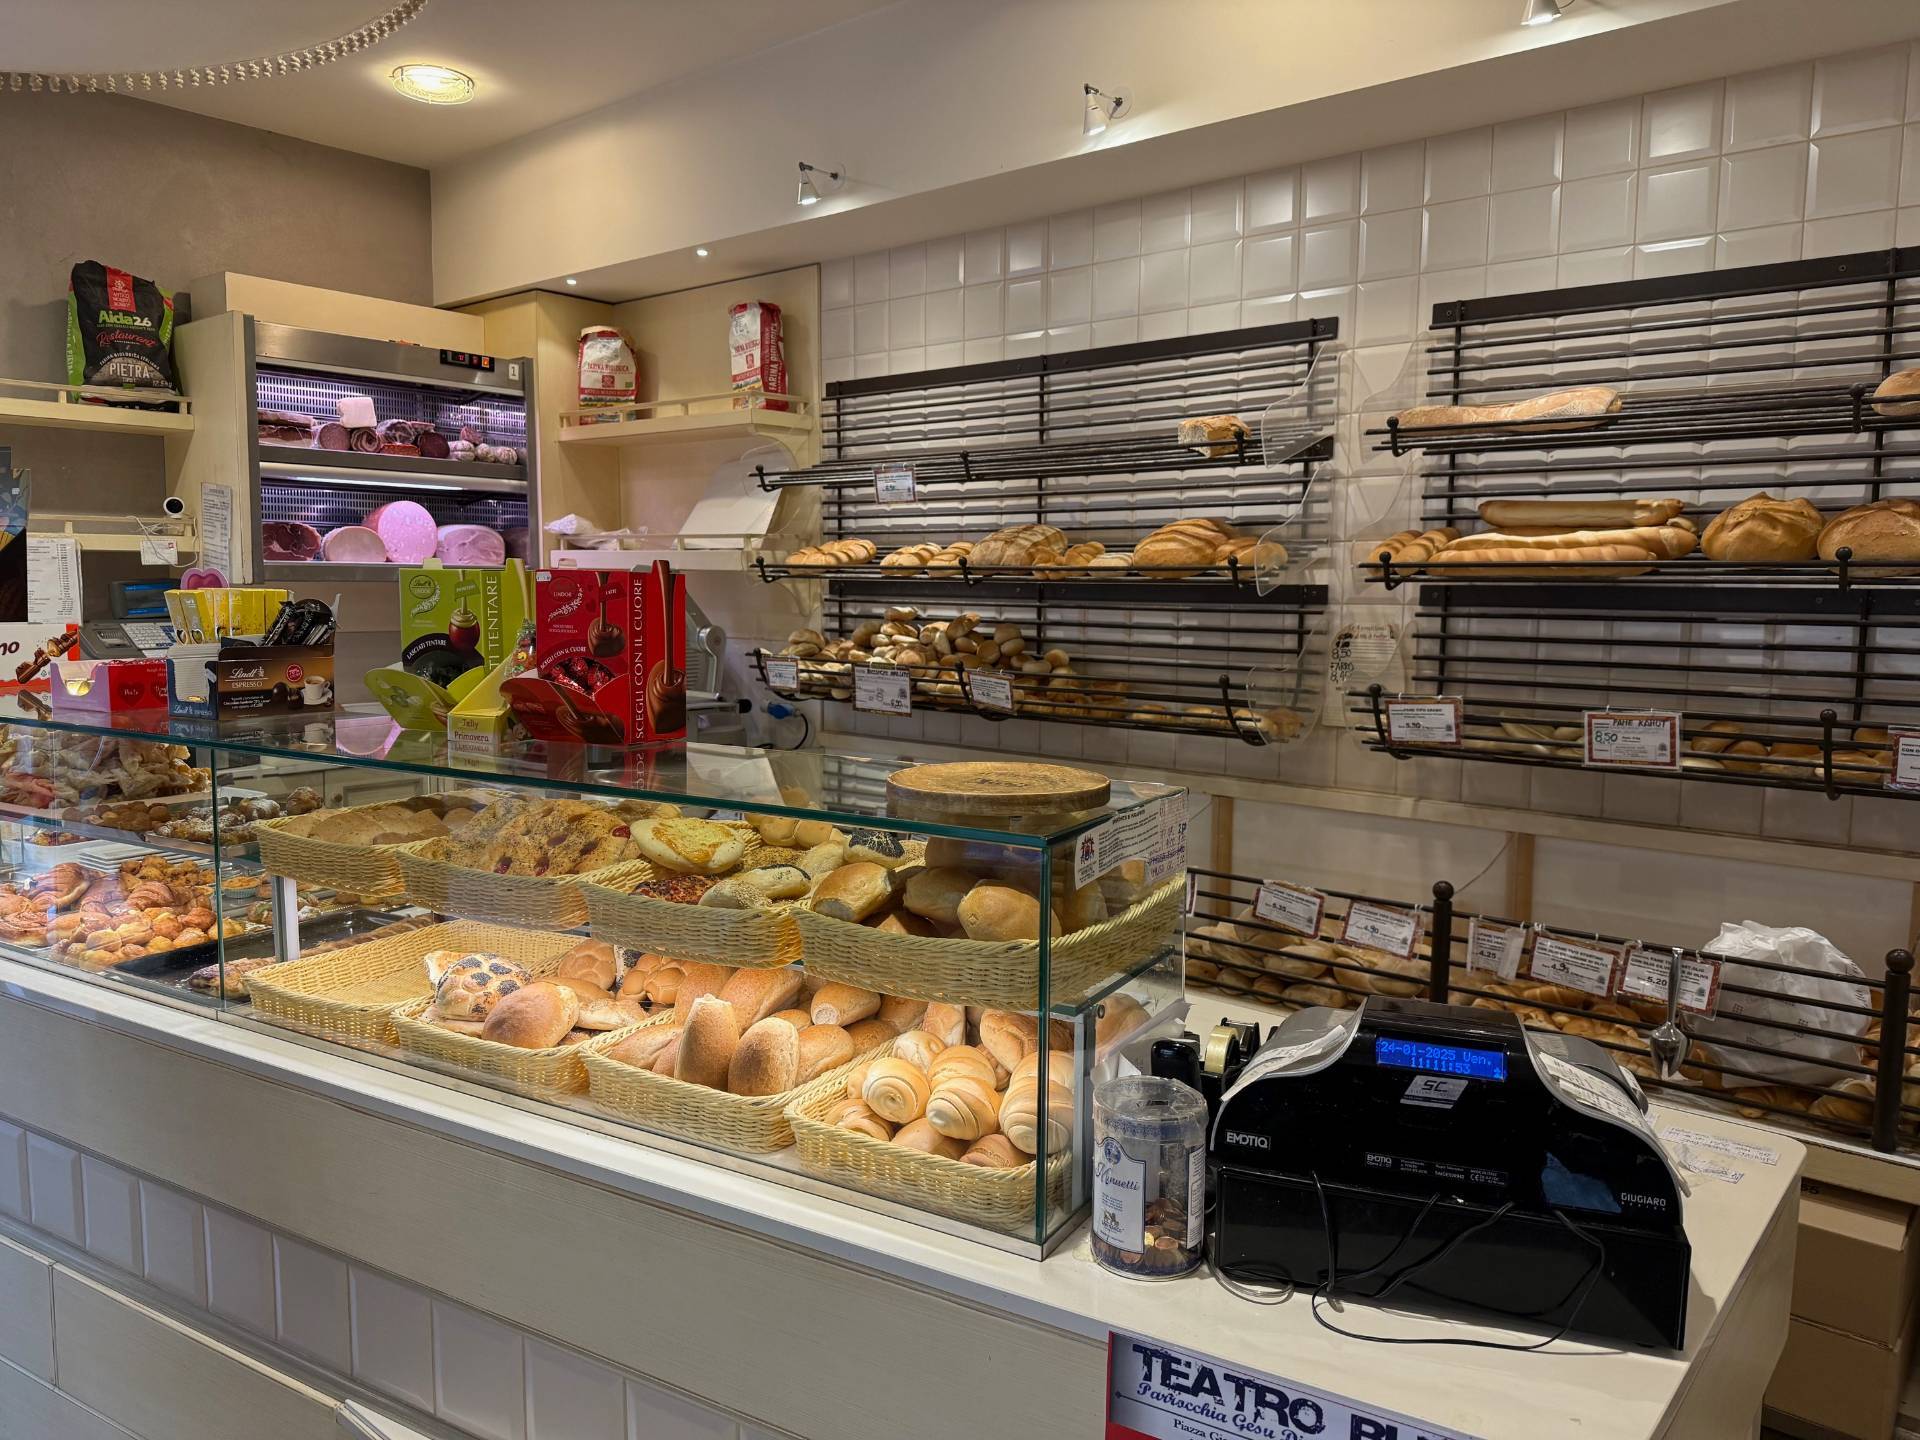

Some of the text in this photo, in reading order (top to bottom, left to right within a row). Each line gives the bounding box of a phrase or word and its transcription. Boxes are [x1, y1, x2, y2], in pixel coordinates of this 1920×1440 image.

[99, 310, 152, 327] Aida26
[109, 362, 150, 379] PIETRA
[511, 366, 516, 377] 1
[769, 362, 779, 391] FARINA
[486, 576, 500, 648] TENTARE
[426, 639, 447, 647] TENTARE
[633, 579, 645, 739] SCEGLI CON IL CUORE
[229, 667, 257, 679] Lindt
[231, 681, 263, 689] ESPRESSO
[173, 704, 189, 714] Lindt
[462, 718, 479, 729] Jelly
[454, 731, 489, 742] Primavera
[1479, 950, 1497, 959] 4.25
[1646, 976, 1667, 986] 5.20
[1380, 1041, 1457, 1061] 24-01-2025
[1410, 1056, 1471, 1074] 11:11:53
[1421, 1080, 1448, 1093] SC
[1226, 1131, 1268, 1149] EMOTIQ
[1621, 1192, 1666, 1207] GIUGIARO
[1132, 1343, 1326, 1434] TEATRO
[1136, 1382, 1228, 1423] Parrocchia
[1174, 1418, 1207, 1438] Piazza
